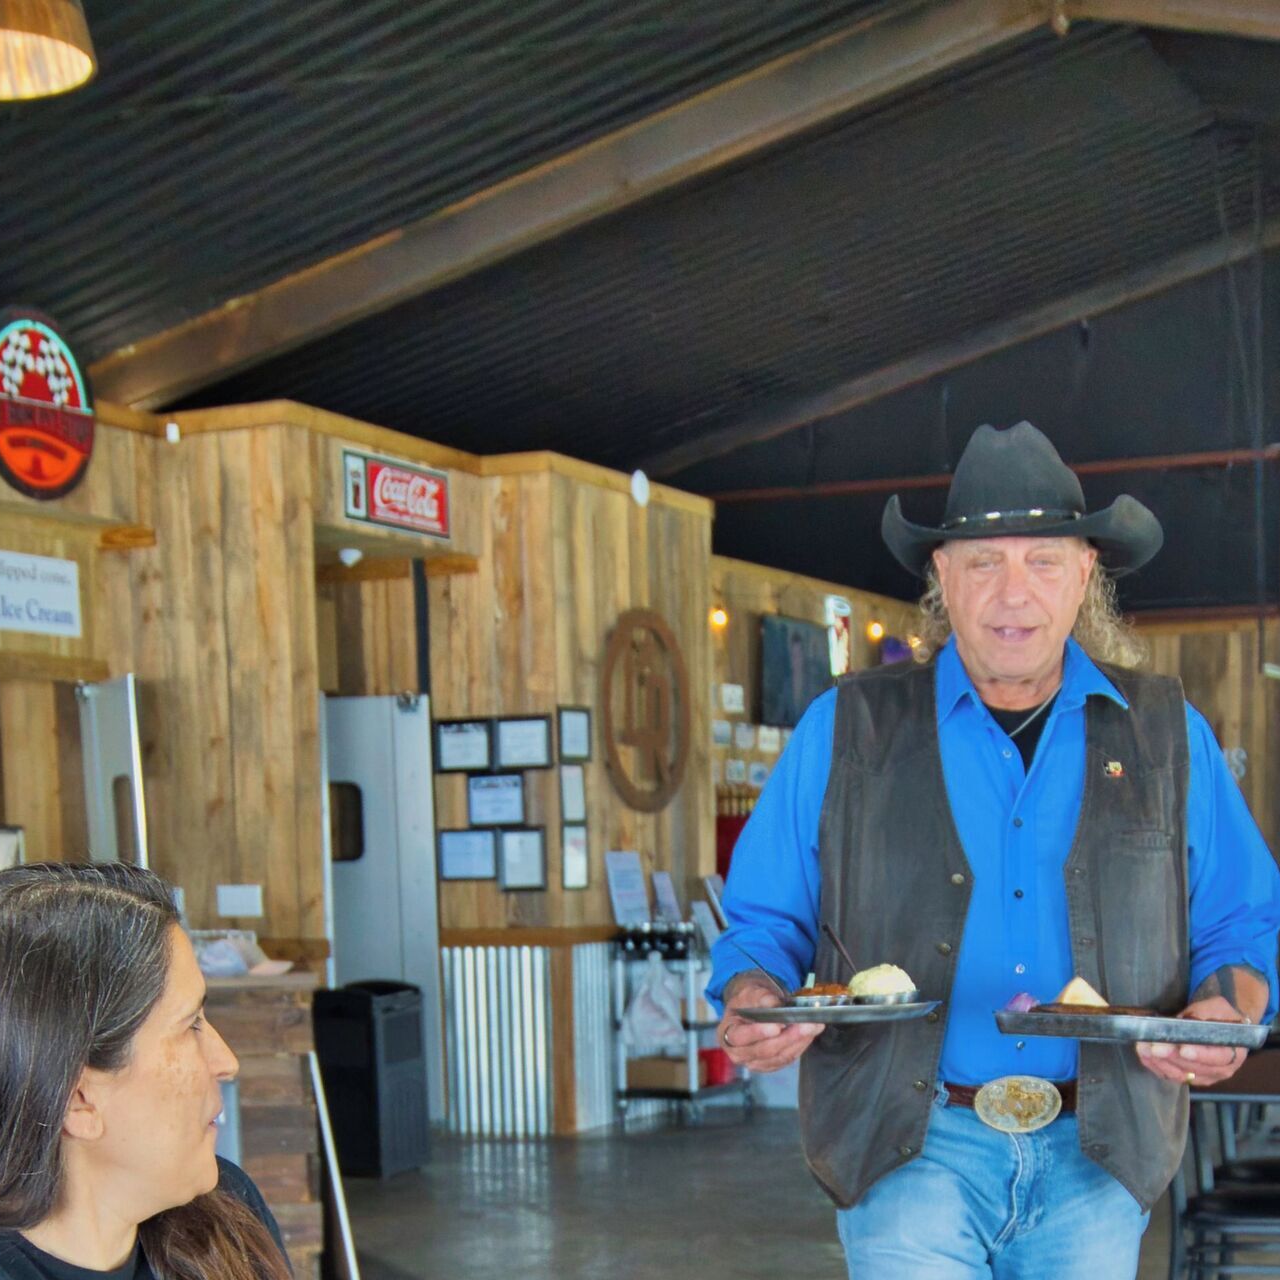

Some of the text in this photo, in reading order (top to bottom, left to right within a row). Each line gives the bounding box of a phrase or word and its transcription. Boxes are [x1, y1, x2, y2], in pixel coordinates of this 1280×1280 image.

[373, 467, 439, 518] Coca-Cola
[0, 595, 23, 620] Ice
[25, 598, 75, 625] Cream
